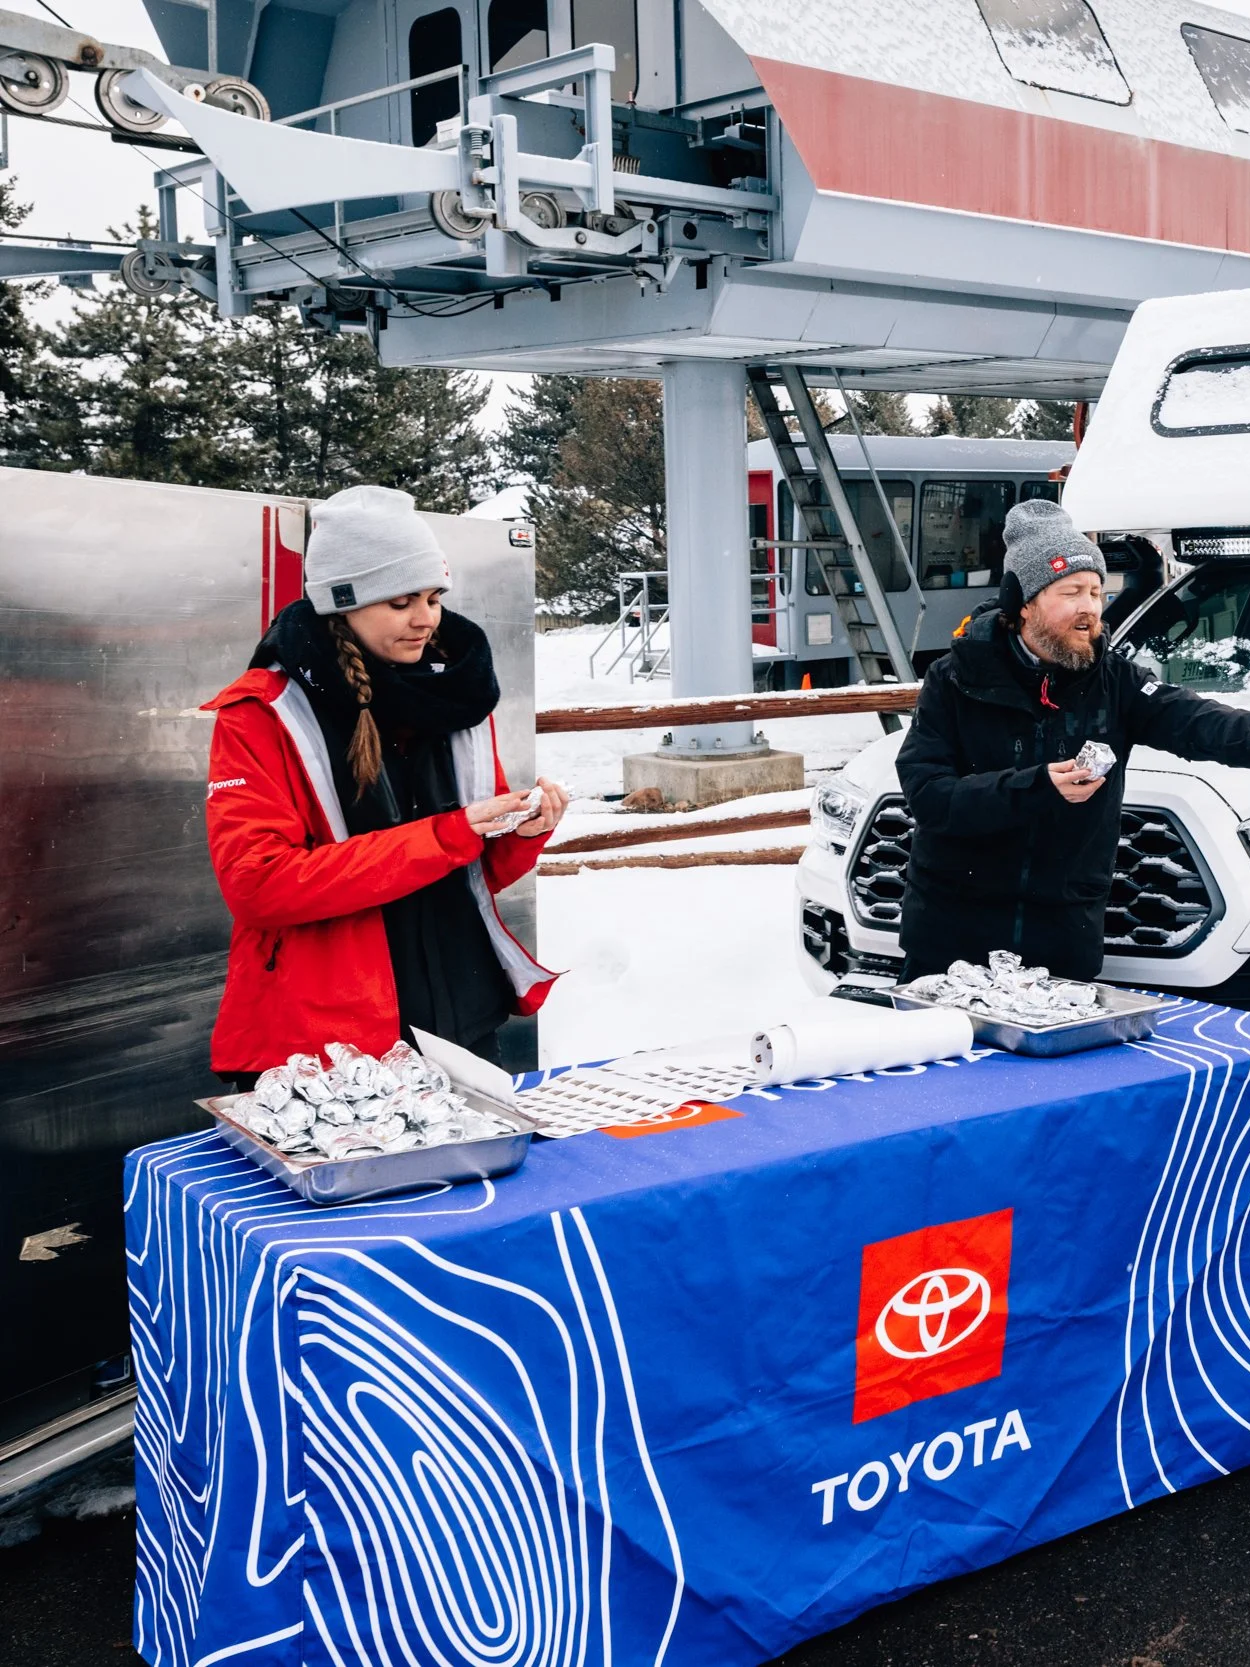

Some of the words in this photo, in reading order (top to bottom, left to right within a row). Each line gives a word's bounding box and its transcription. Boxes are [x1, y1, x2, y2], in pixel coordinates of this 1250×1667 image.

[1067, 554, 1094, 564] TOYOTA
[213, 778, 246, 790] TOYOTA
[811, 1409, 1032, 1526] TOYOTA
